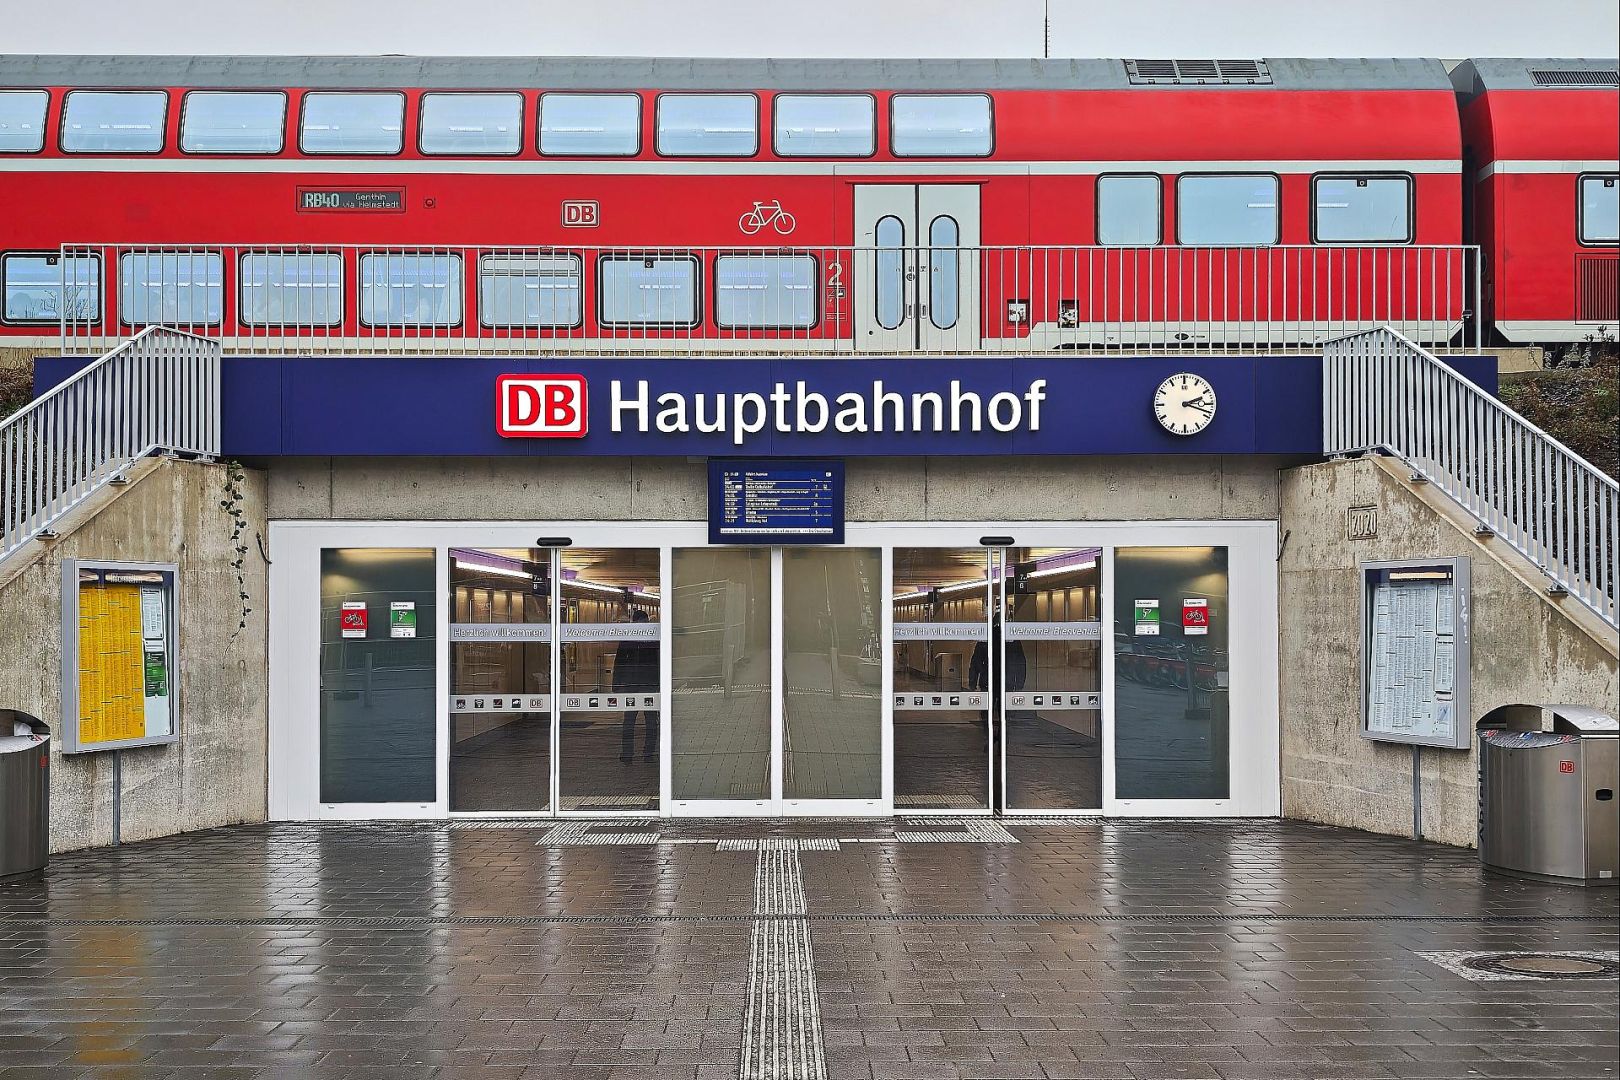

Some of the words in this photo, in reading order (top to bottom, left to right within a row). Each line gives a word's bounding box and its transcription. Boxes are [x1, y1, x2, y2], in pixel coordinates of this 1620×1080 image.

[304, 193, 340, 208] RB40
[355, 193, 387, 201] Genthin
[567, 205, 594, 222] DB
[828, 262, 843, 286] 2
[508, 384, 576, 427] DB
[611, 379, 1046, 444] Hauptbahnhof
[454, 628, 488, 637] Herzlich
[491, 628, 547, 637] willkommen!
[530, 699, 543, 707] DB
[568, 698, 579, 706] DB
[1561, 762, 1573, 771] DB
